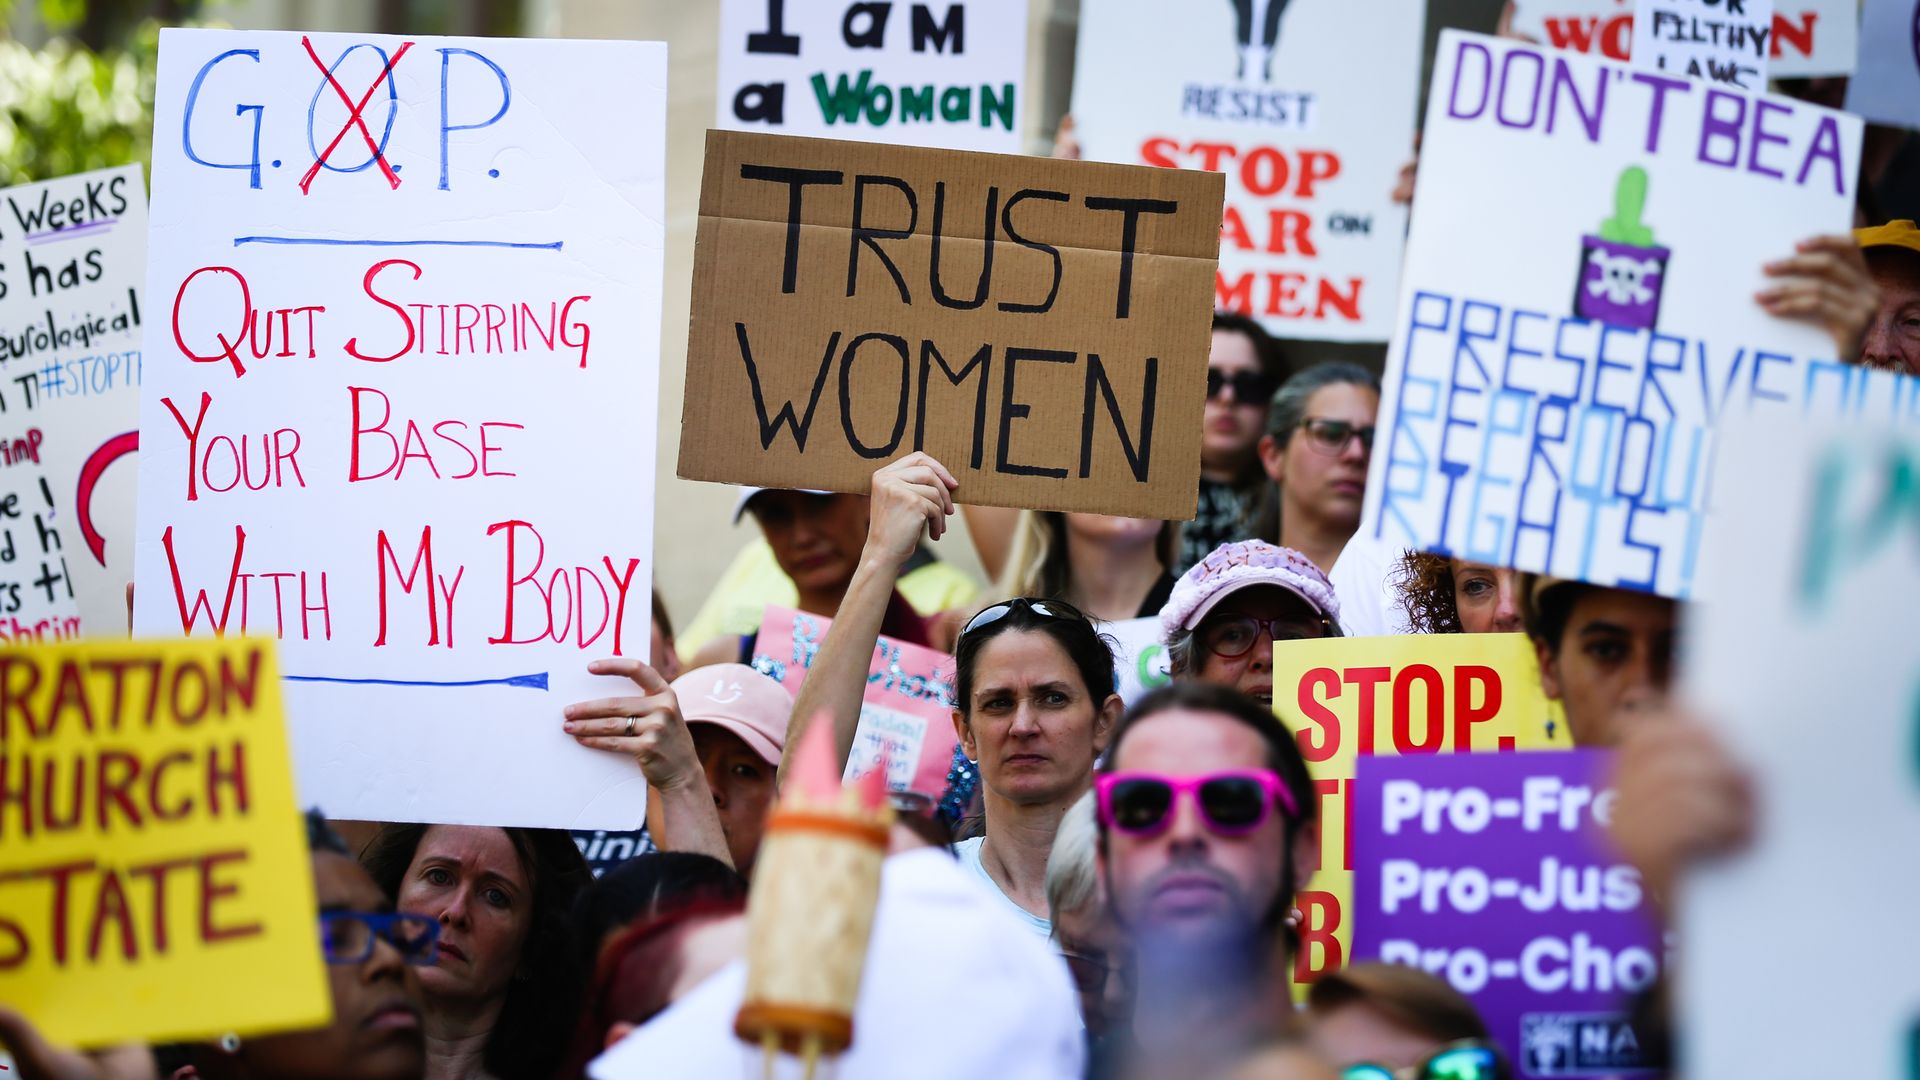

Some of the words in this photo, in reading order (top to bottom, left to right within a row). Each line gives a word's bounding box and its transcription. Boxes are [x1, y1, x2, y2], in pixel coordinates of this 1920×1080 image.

[747, 0, 801, 55] I
[1653, 9, 1770, 58] FILTHY
[732, 82, 785, 125] a
[1181, 83, 1316, 127] RESIST
[1448, 42, 1691, 154] DON'T
[1140, 138, 1342, 198] STOP
[24, 248, 103, 297] has
[740, 163, 1178, 320] TRUST
[1219, 206, 1318, 258] AR
[1327, 211, 1375, 237] ON
[172, 266, 326, 378] QUIT
[344, 259, 593, 368] STIRRING
[1214, 268, 1363, 322] MEN
[160, 391, 306, 501] YOUR
[347, 385, 524, 483] BASE
[734, 321, 1159, 484] WOMEN
[1387, 374, 1720, 512] REPRODU
[161, 524, 332, 641] WITH
[373, 524, 465, 649] MY
[486, 519, 641, 656] BODY
[0, 647, 264, 743] RATION
[1296, 663, 1516, 763] STOP.
